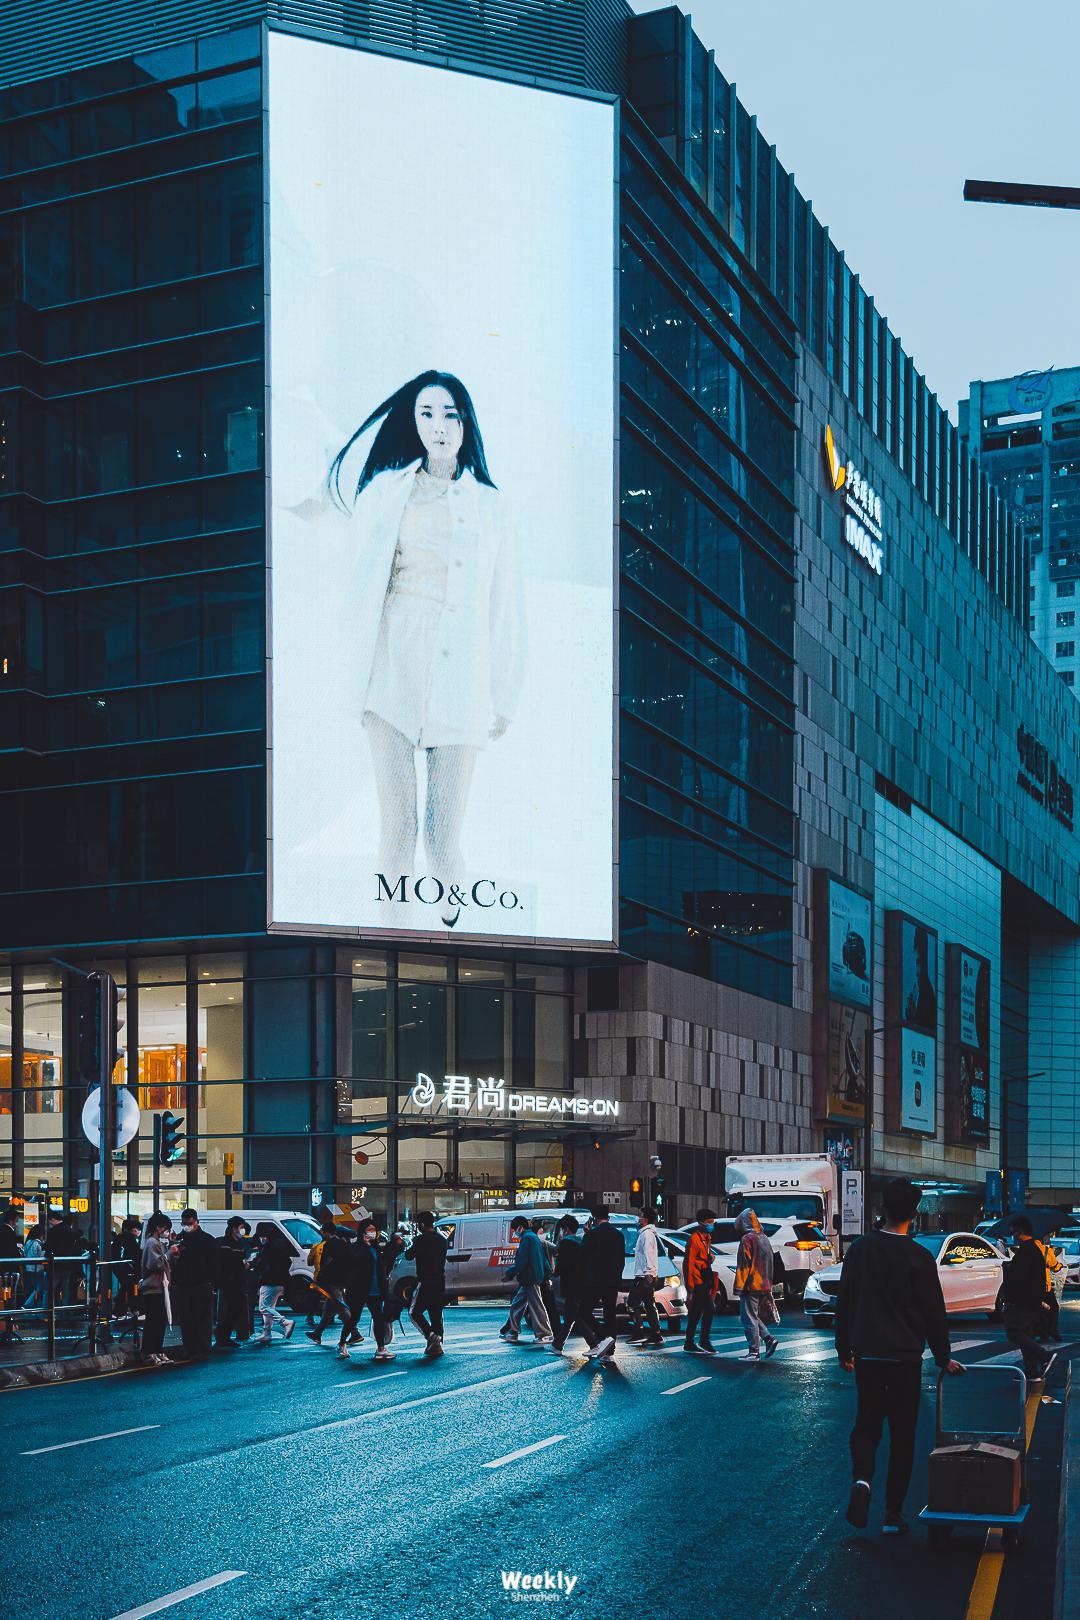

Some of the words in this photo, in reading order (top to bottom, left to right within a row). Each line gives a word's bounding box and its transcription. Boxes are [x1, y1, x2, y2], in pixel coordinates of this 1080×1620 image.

[846, 514, 883, 576] IMAX
[374, 873, 524, 910] MO&Co.
[441, 1075, 505, 1111] 君尚
[508, 1094, 620, 1117] DREAMS-ON
[752, 1179, 800, 1189] ISUZU
